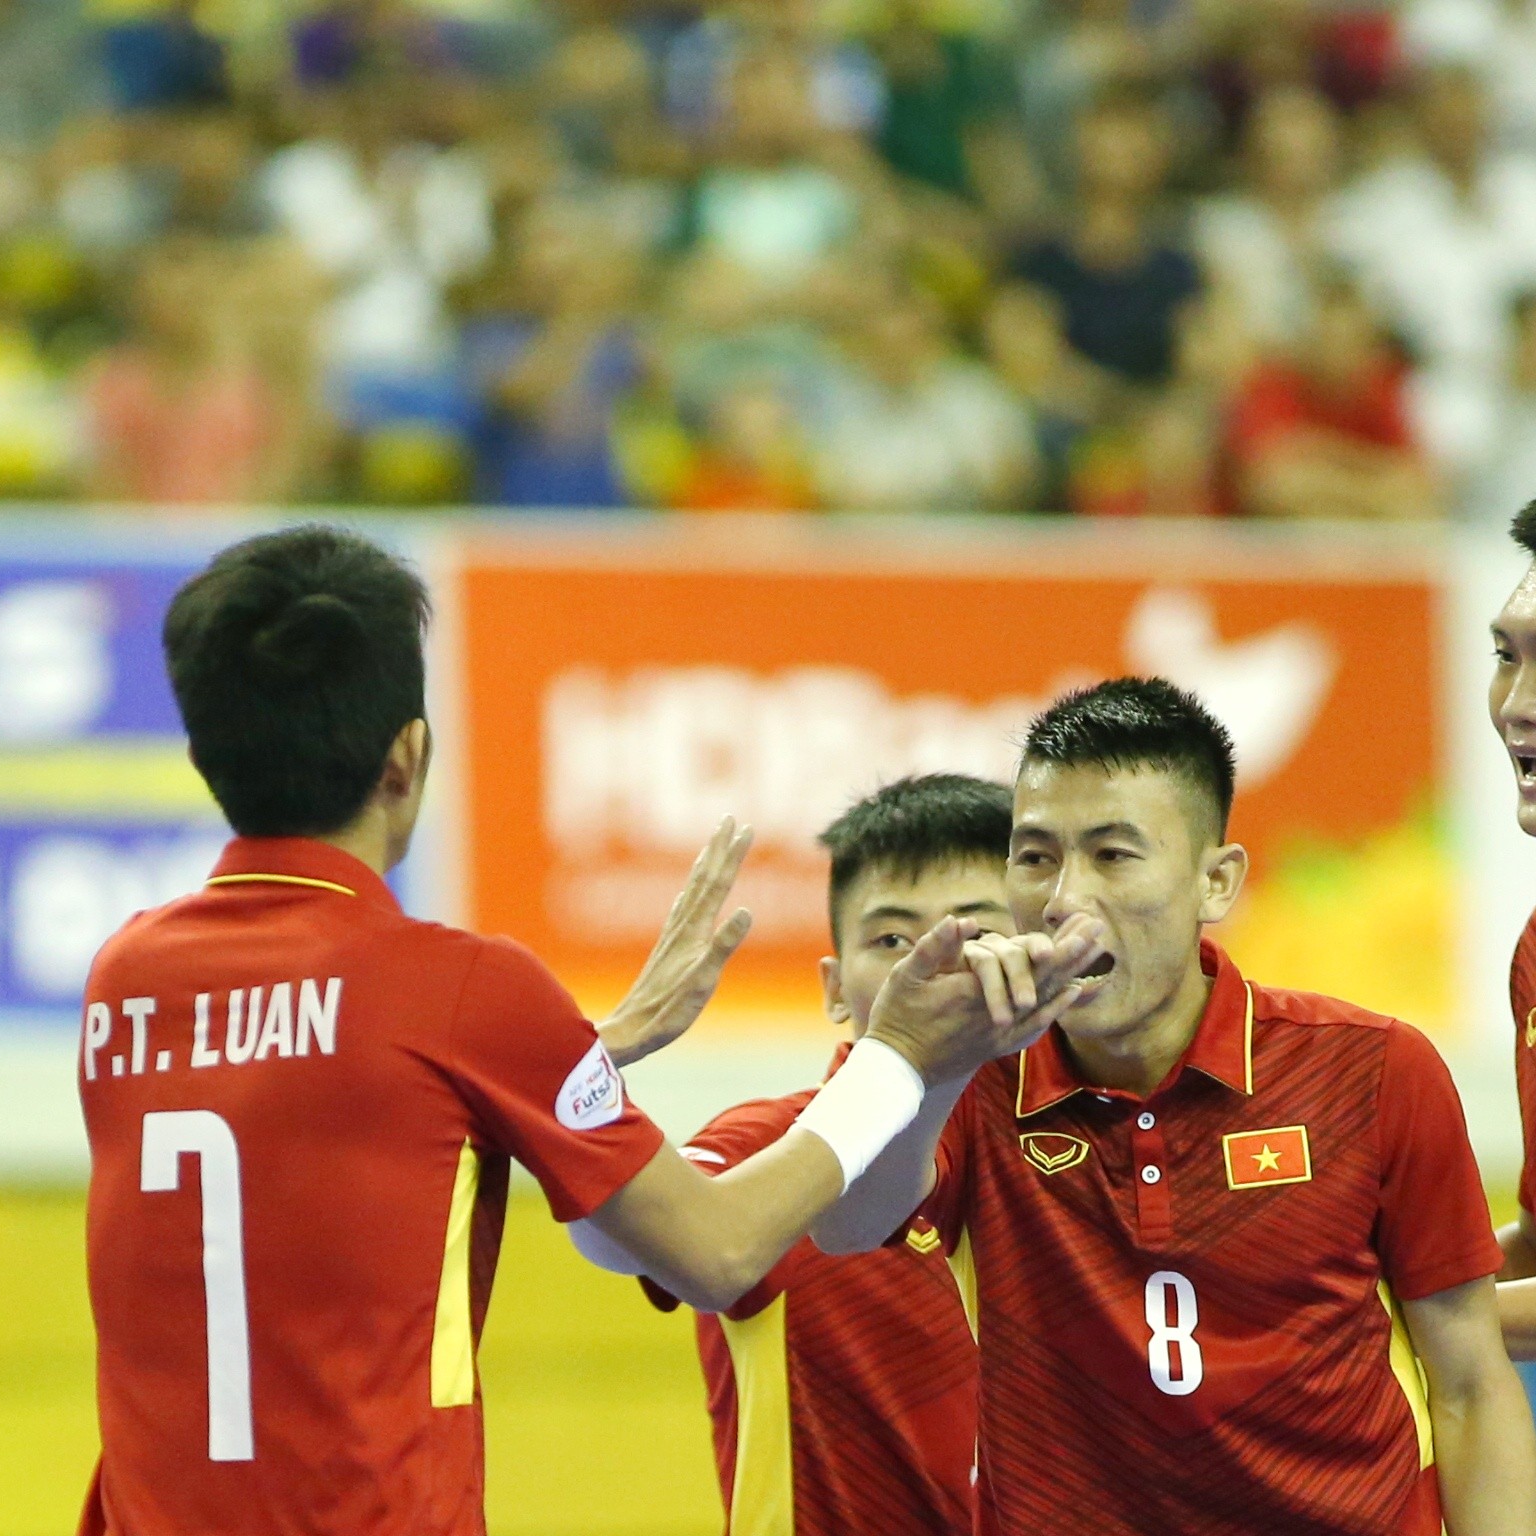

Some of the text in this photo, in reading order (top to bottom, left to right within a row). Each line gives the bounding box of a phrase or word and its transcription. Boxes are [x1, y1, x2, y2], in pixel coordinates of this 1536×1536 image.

[83, 977, 343, 1080] P.T. LUAN
[140, 1109, 254, 1461] 7
[1144, 1271, 1203, 1396] 8
